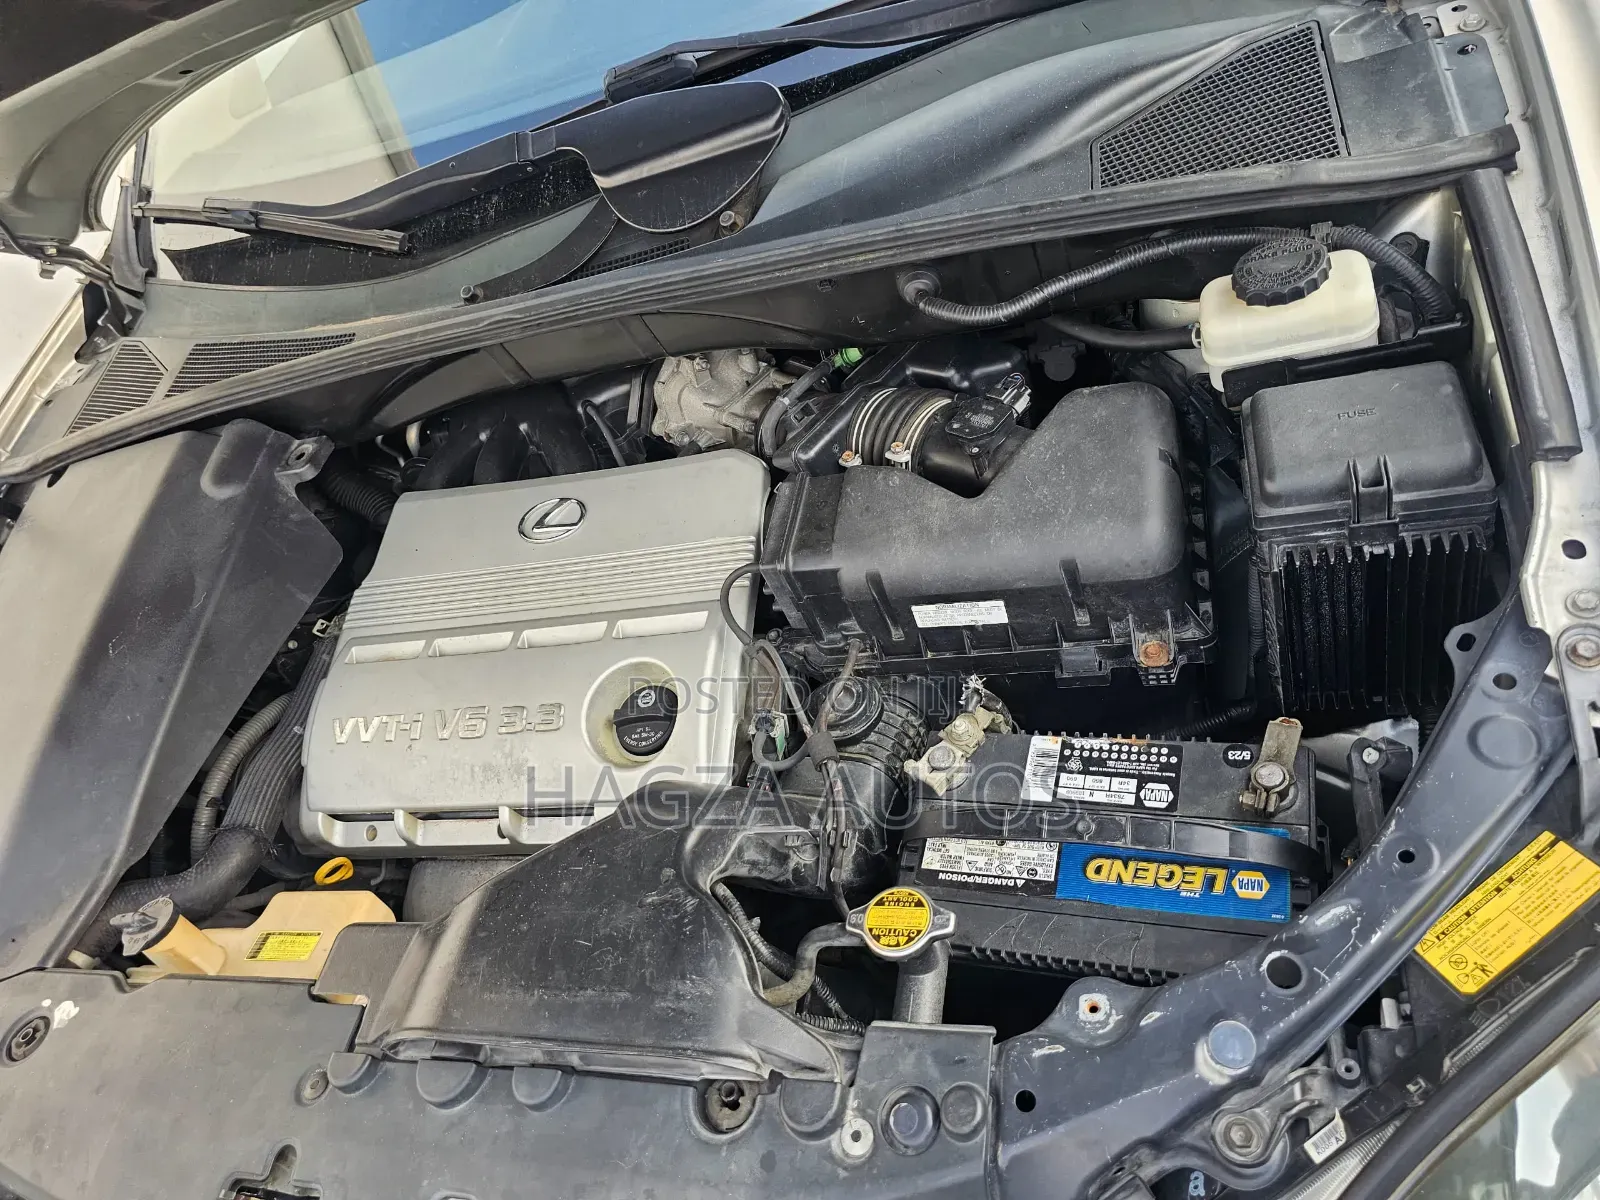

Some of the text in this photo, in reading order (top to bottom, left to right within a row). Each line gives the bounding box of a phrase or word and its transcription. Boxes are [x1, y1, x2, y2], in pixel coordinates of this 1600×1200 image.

[1243, 251, 1278, 263] BRAKE
[1282, 243, 1315, 255] FLUID
[1337, 407, 1377, 420] FUSE
[333, 703, 565, 744] VVT-i V6 3.3
[1228, 750, 1252, 761] 5/23
[1142, 788, 1170, 802] NAPA
[1084, 856, 1230, 895] LEGEND
[1509, 856, 1537, 879] ACHTUNG
[938, 872, 1015, 886] DANGER/POISON
[1237, 877, 1264, 893] NAPA
[1467, 889, 1497, 914] ATTENTION
[871, 928, 918, 937] CAUTION
[1443, 913, 1468, 934] CAUTION
